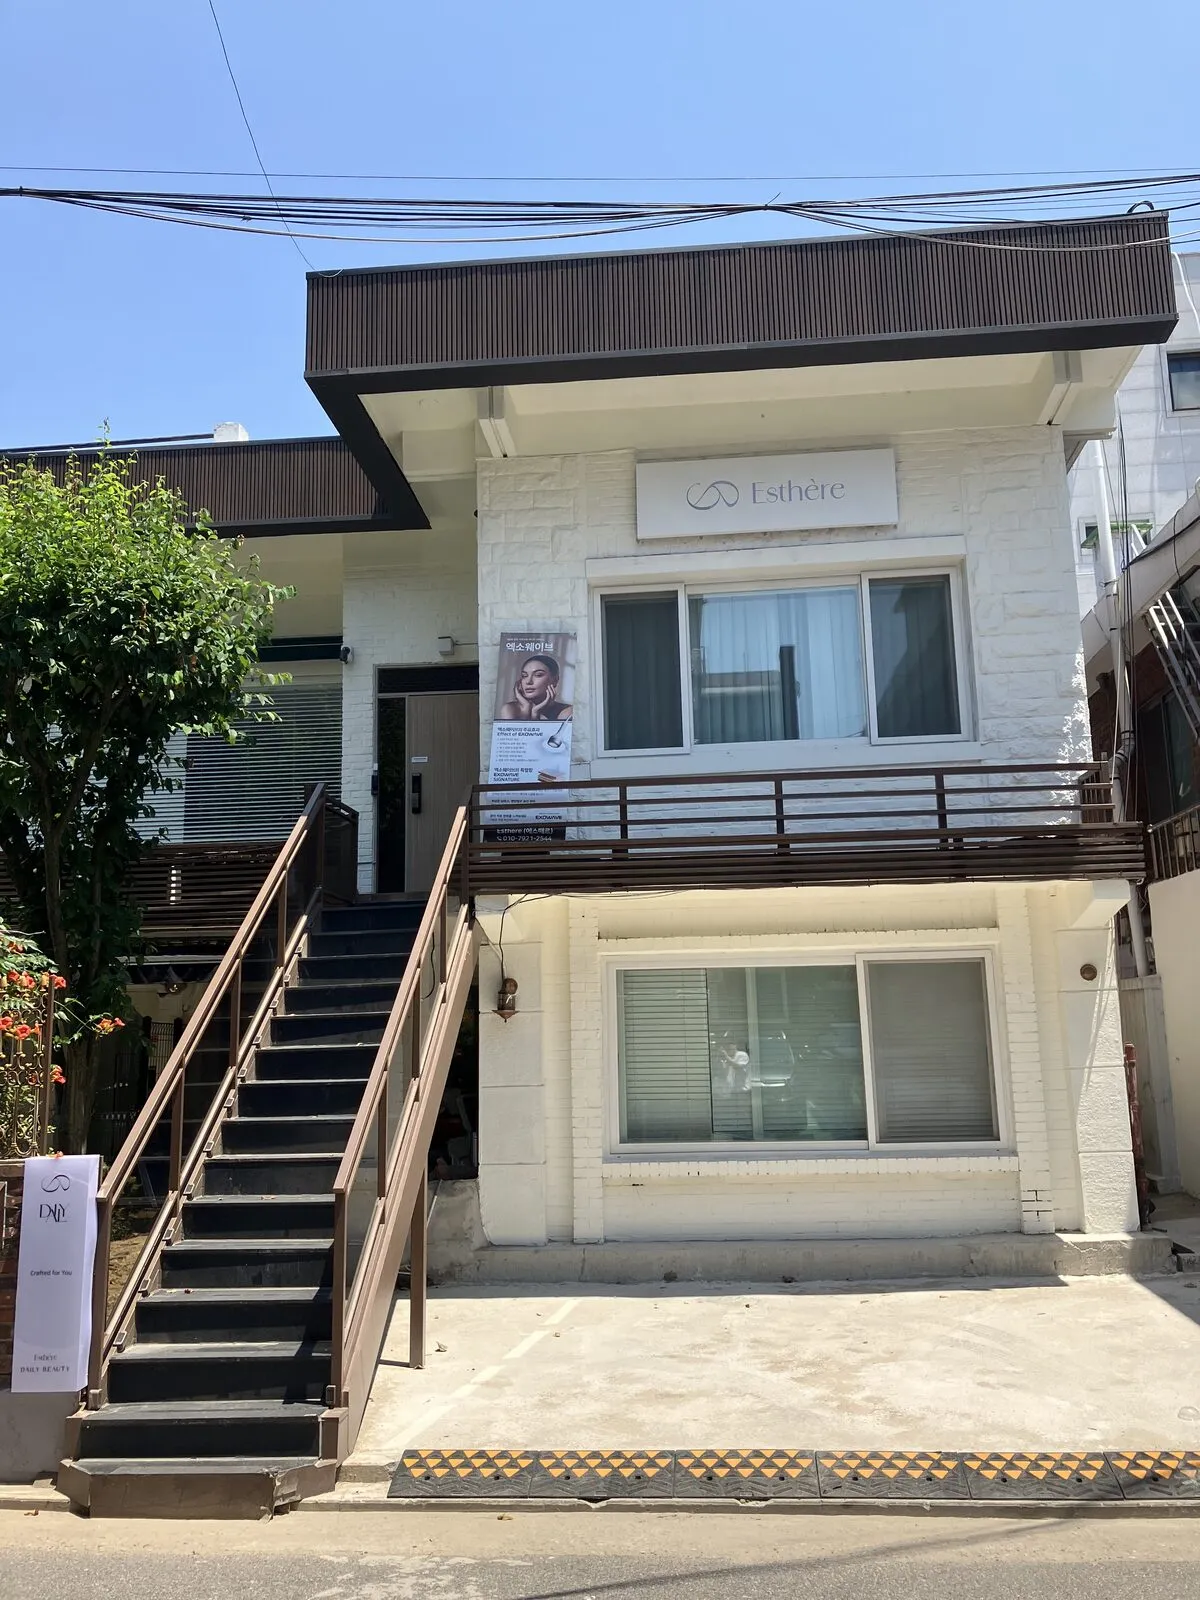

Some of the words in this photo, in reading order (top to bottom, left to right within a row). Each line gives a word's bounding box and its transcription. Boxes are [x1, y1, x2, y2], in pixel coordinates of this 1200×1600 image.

[752, 479, 845, 504] Esthère
[506, 642, 554, 652] 엑소웨이브
[42, 1365, 70, 1373] BEAUTY
